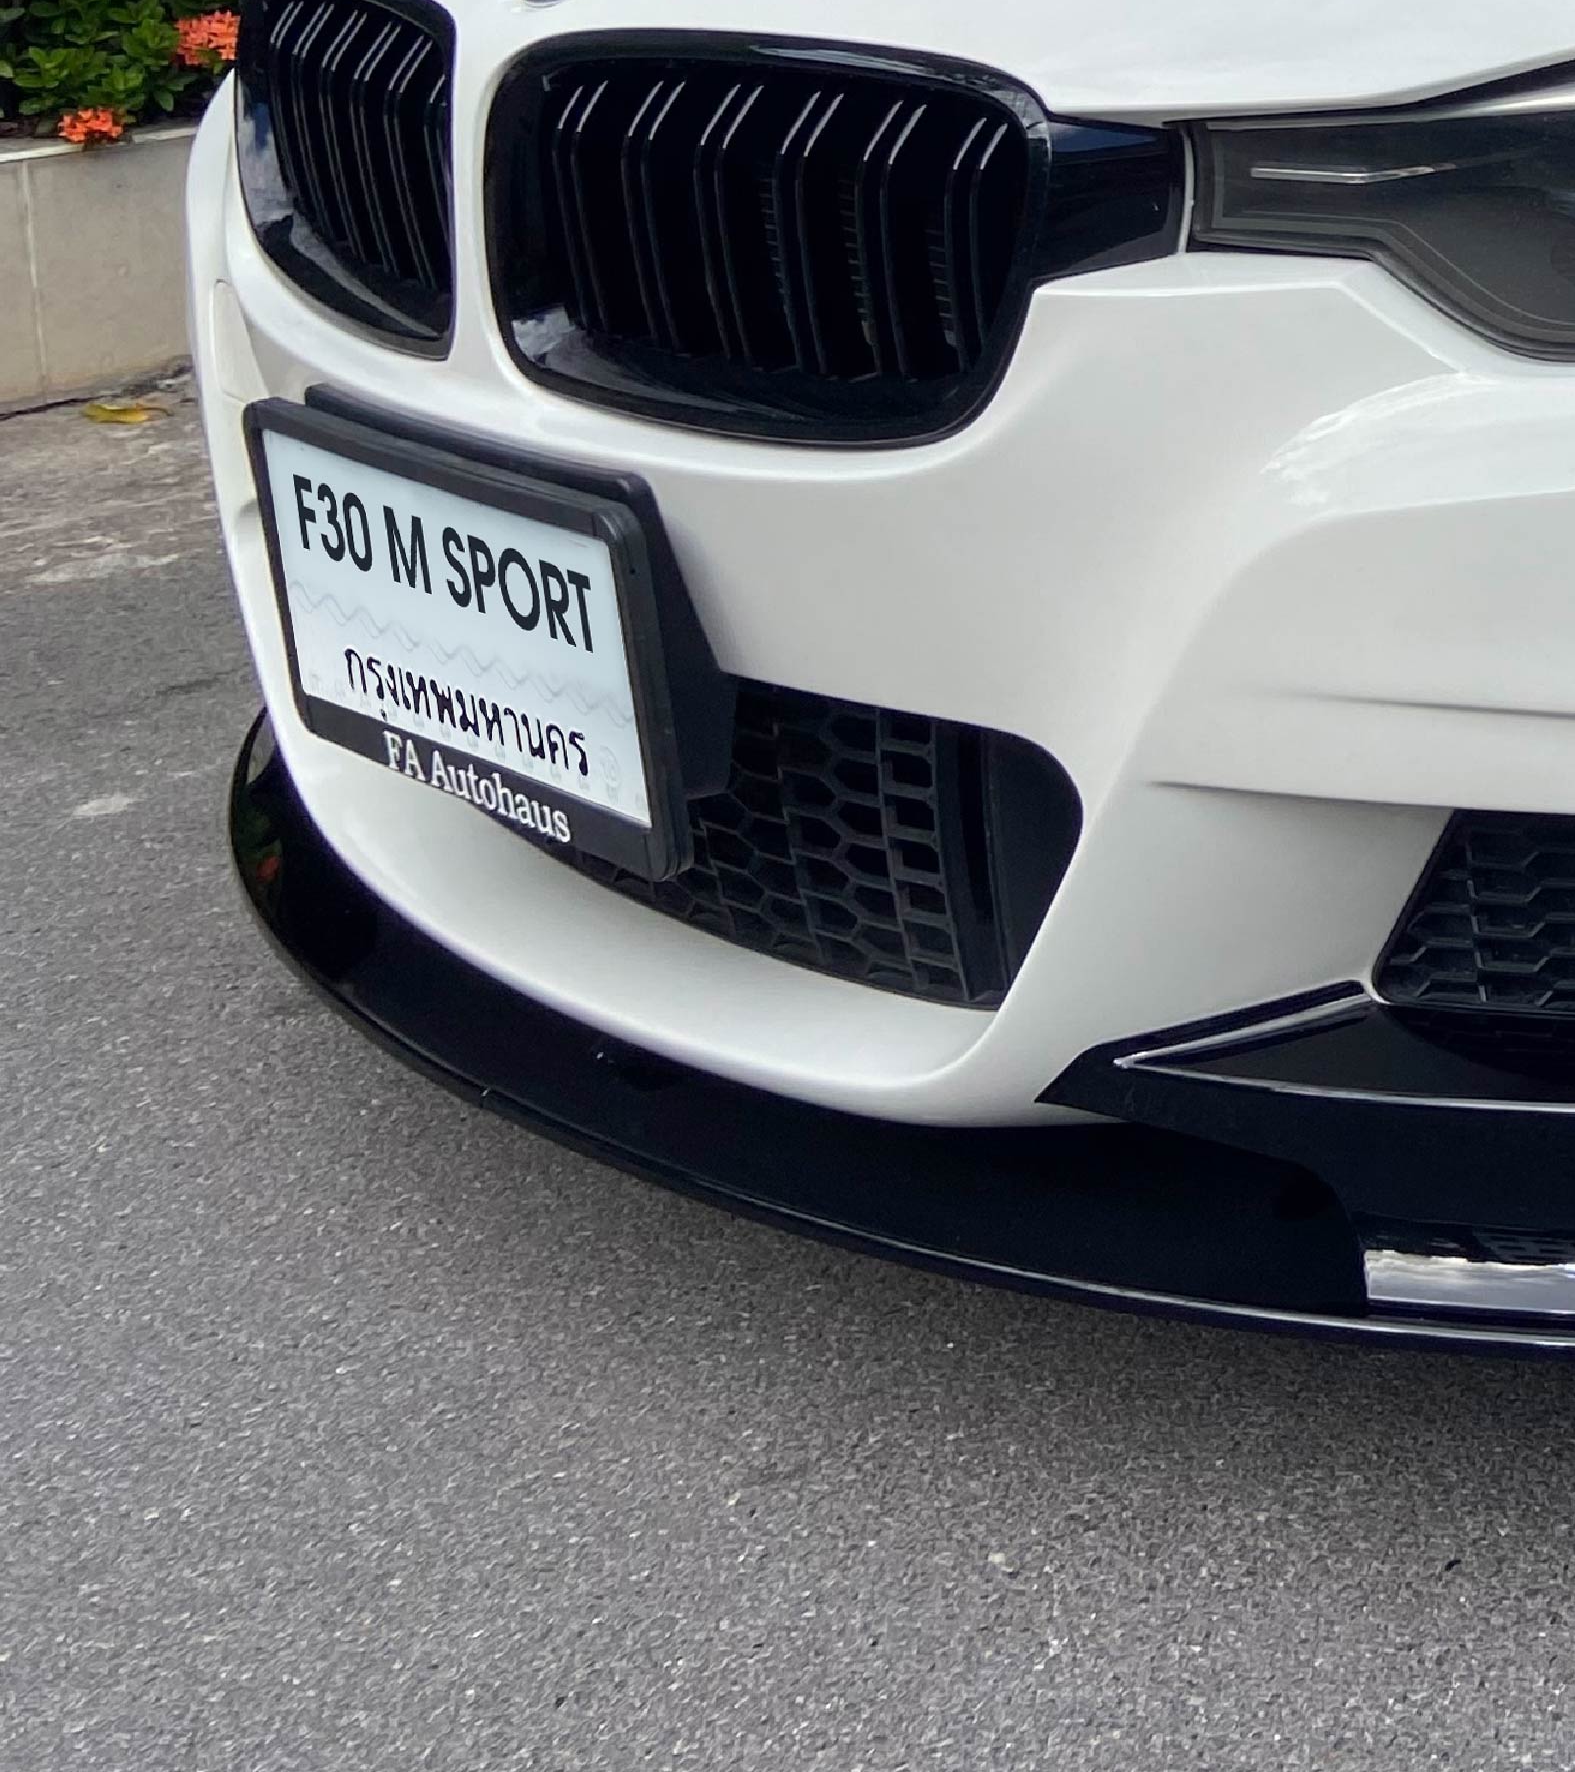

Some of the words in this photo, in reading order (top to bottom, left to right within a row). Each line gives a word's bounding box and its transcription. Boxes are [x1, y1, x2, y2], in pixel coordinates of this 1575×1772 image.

[293, 474, 373, 572] F30
[383, 505, 433, 595] M
[442, 527, 594, 654] SPORT
[344, 648, 589, 776] กรุงเทพมหานคร
[383, 730, 427, 783] FA
[431, 749, 572, 844] Autohaus
